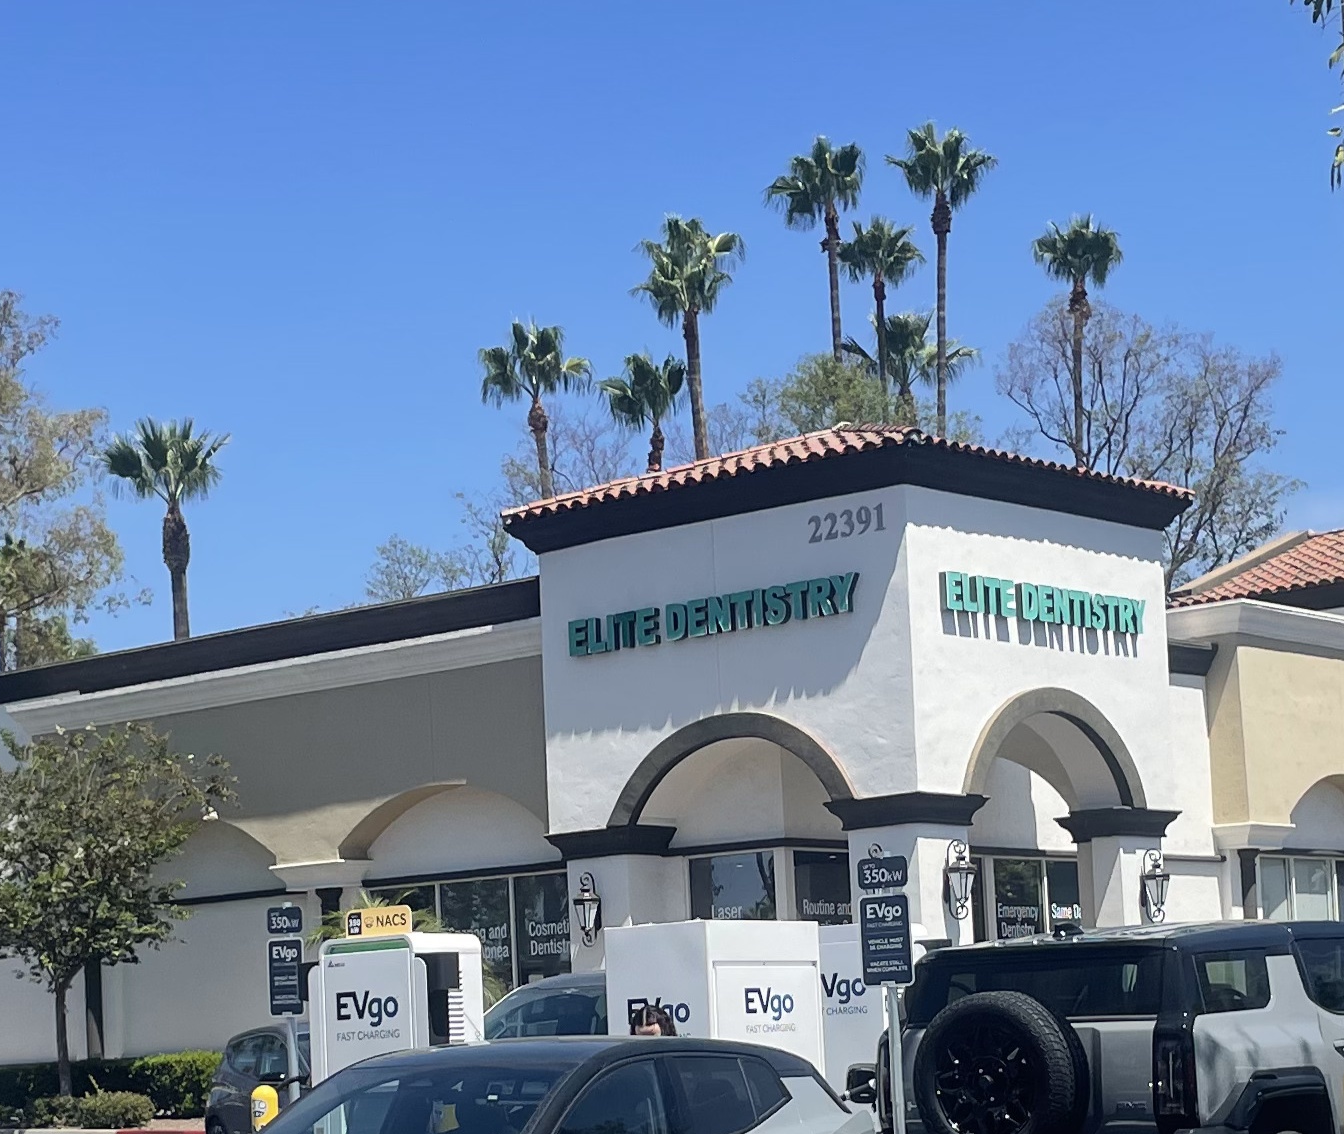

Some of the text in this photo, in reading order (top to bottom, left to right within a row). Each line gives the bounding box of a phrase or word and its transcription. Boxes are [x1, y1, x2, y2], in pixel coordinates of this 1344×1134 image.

[808, 503, 886, 544] 22391
[939, 571, 1146, 634] ELITE DENTISTRY
[568, 572, 860, 657] ELITE DENTISTRY
[863, 868, 903, 884] 350kW
[711, 904, 743, 920] Laser
[803, 899, 835, 915] Routine
[866, 903, 902, 921] EVgo
[998, 902, 1039, 921] Emergency
[1051, 902, 1082, 919] Same Da
[376, 913, 407, 928] NACS
[528, 918, 570, 937] Cosmeti
[1001, 920, 1036, 939] Dentistry
[488, 923, 507, 940] and
[272, 946, 298, 962] EVgo
[530, 937, 571, 956] Dentistr
[821, 973, 866, 1004] Vgo
[336, 990, 399, 1027] EVgo
[745, 986, 795, 1021] EVgo
[826, 1004, 868, 1015] CHARGING
[337, 1028, 401, 1042] FAST CHARGING
[746, 1023, 796, 1034] FAST CHARGING
